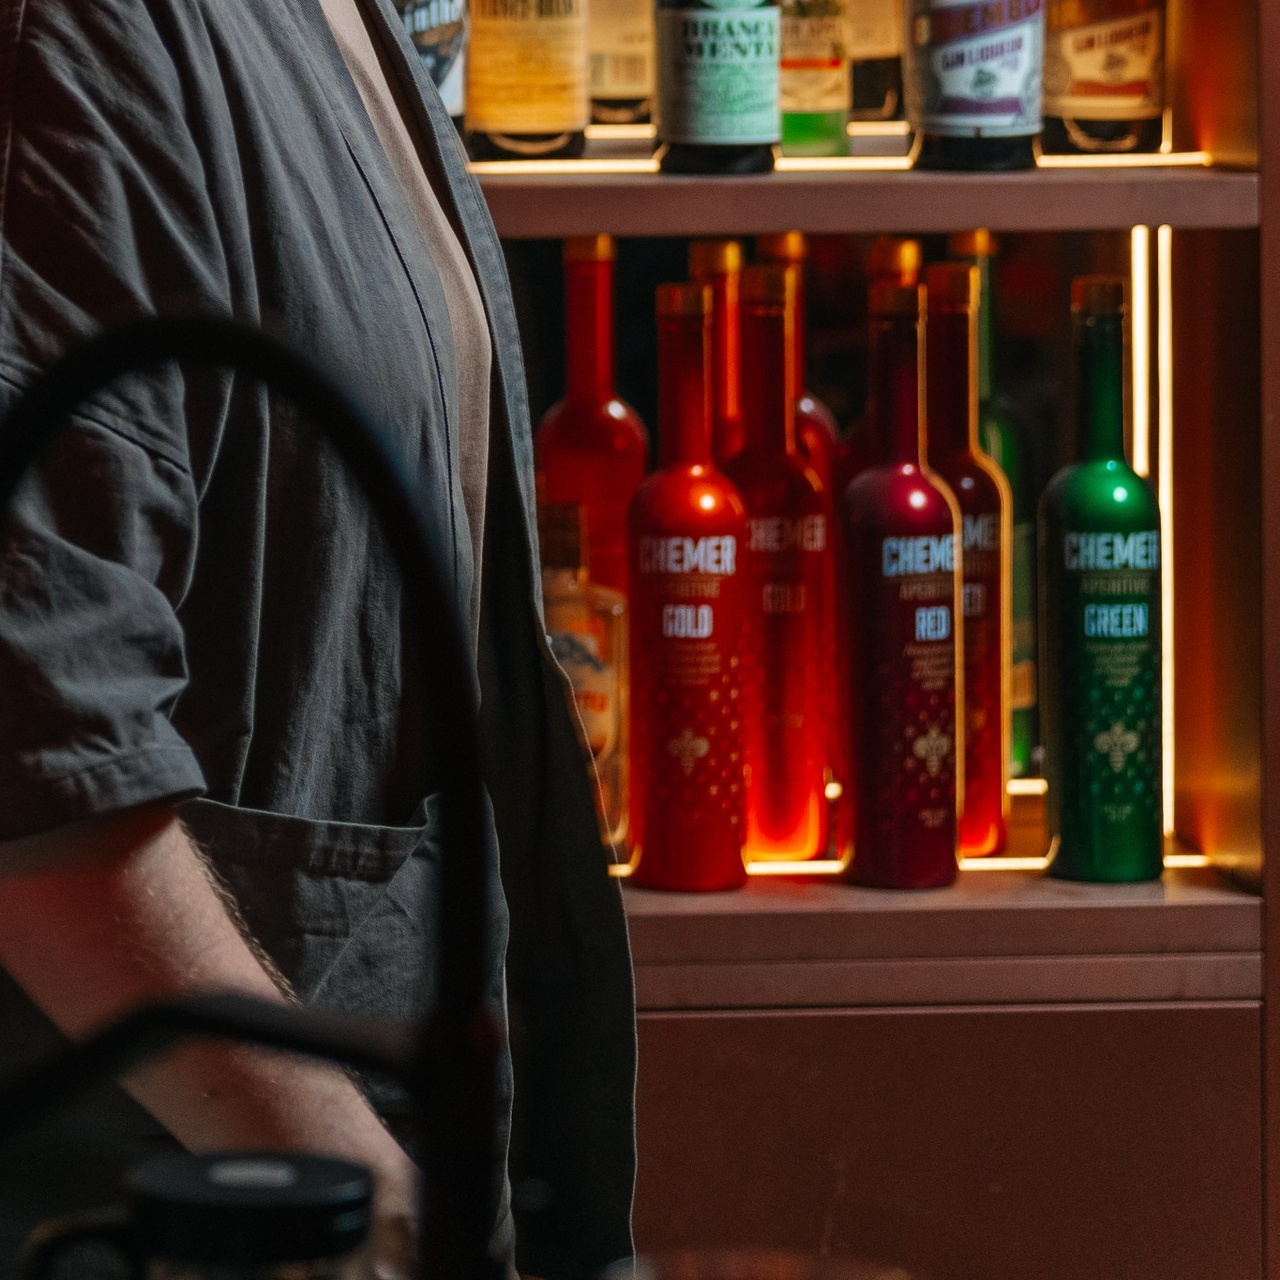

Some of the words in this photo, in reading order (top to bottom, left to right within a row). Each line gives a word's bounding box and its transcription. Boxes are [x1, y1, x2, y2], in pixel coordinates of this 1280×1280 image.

[882, 534, 960, 577] CHEME
[662, 604, 714, 638] GOLD
[915, 606, 951, 642] RED
[1084, 603, 1149, 637] GREEN
